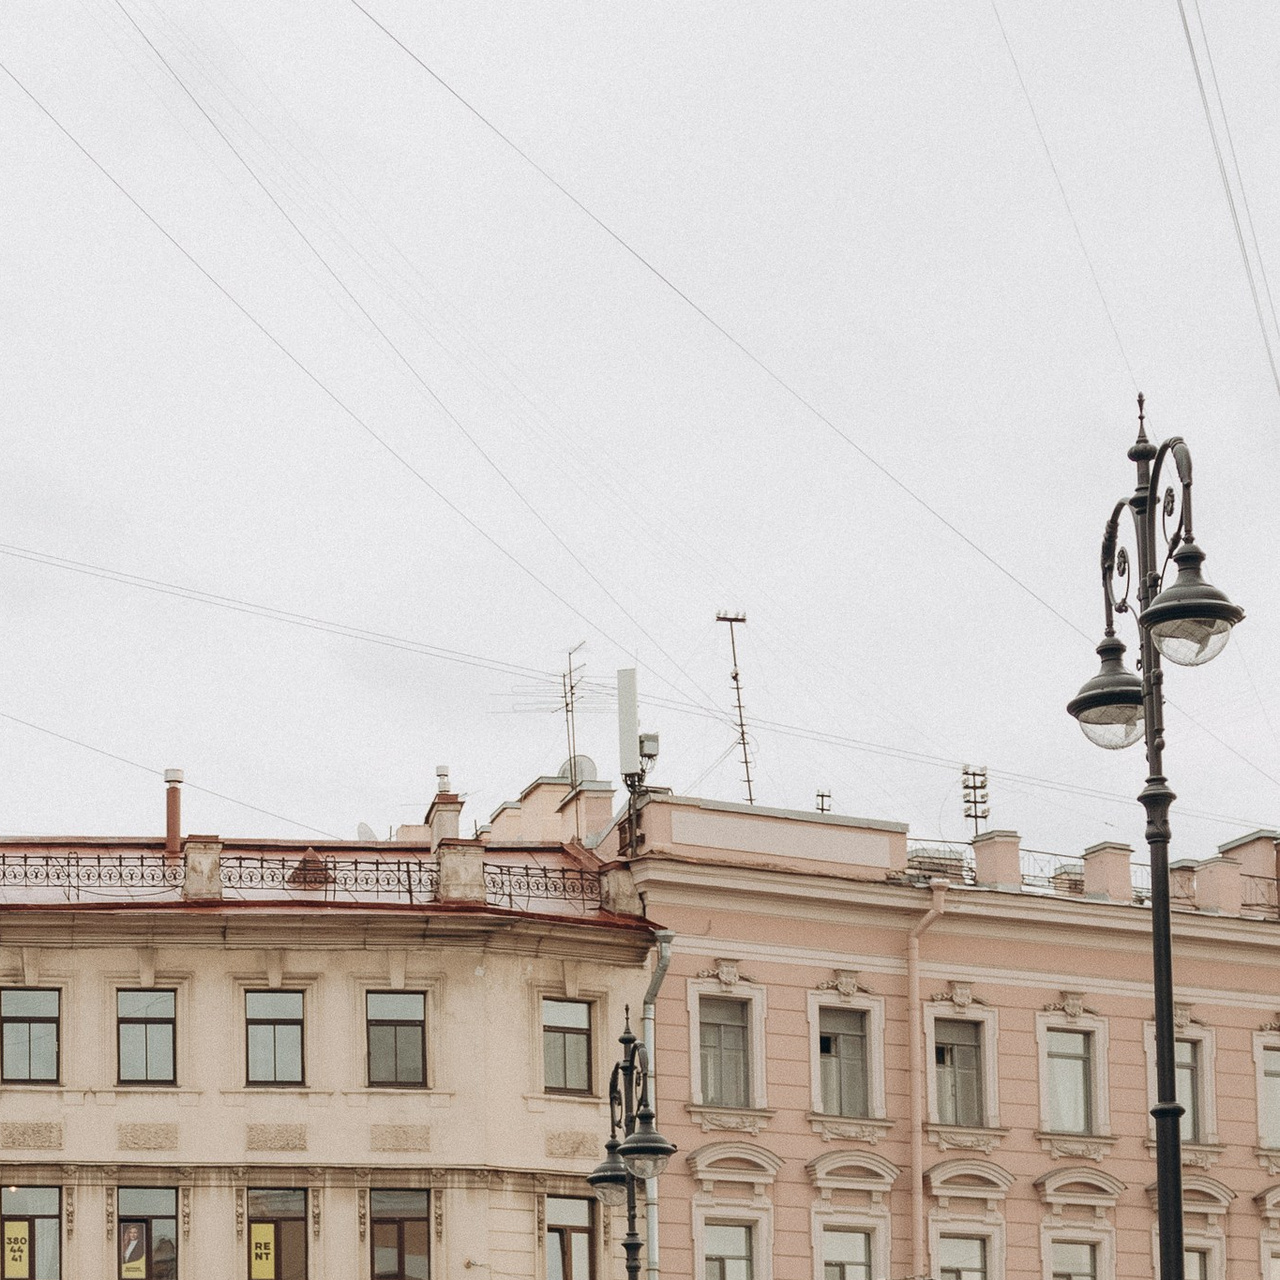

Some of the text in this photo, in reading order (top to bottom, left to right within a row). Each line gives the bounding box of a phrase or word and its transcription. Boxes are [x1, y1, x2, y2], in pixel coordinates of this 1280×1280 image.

[6, 1237, 27, 1245] 380
[10, 1246, 24, 1254] 44
[255, 1242, 271, 1250] RE
[11, 1254, 23, 1263] 41
[255, 1252, 271, 1260] NT
